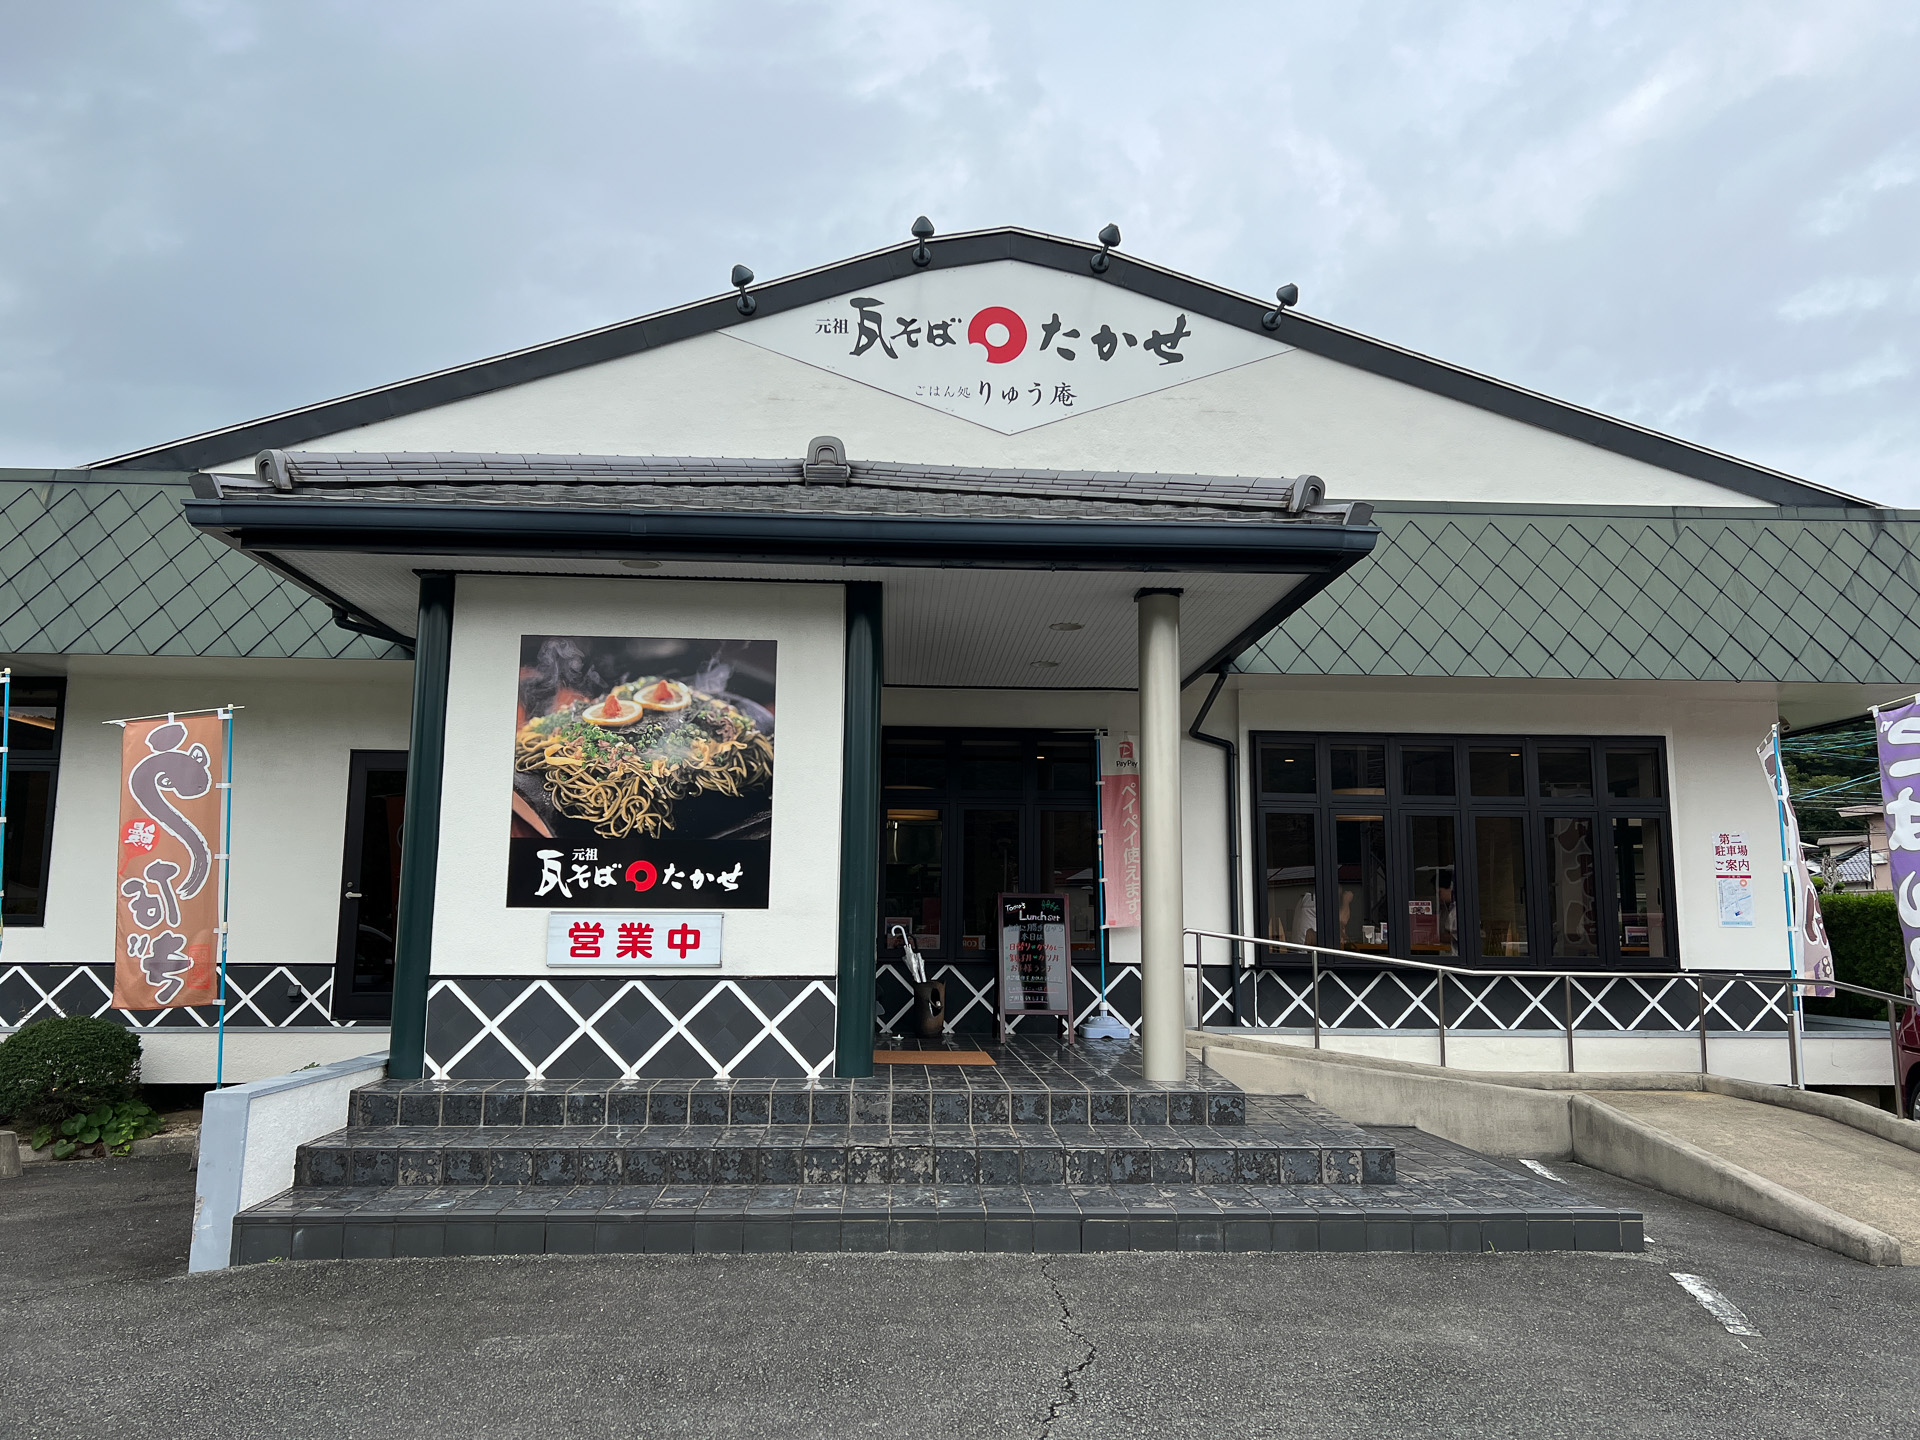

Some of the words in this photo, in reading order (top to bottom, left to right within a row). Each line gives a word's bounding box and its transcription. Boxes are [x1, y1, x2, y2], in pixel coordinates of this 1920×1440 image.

[815, 318, 849, 335] 元祖
[849, 297, 962, 360] 瓦そば
[1040, 312, 1192, 366] たかせ
[914, 384, 971, 400] ごはん処
[978, 380, 1078, 407] りゅう庵
[1116, 760, 1138, 768] PayPay
[1719, 833, 1742, 845] 第二
[571, 847, 599, 861] 元祖
[1715, 845, 1748, 857] 駐車場
[1715, 858, 1750, 872] ご案内
[534, 849, 622, 899] 瓦そば
[661, 862, 744, 892] たかせ
[568, 921, 701, 960] 営業中
